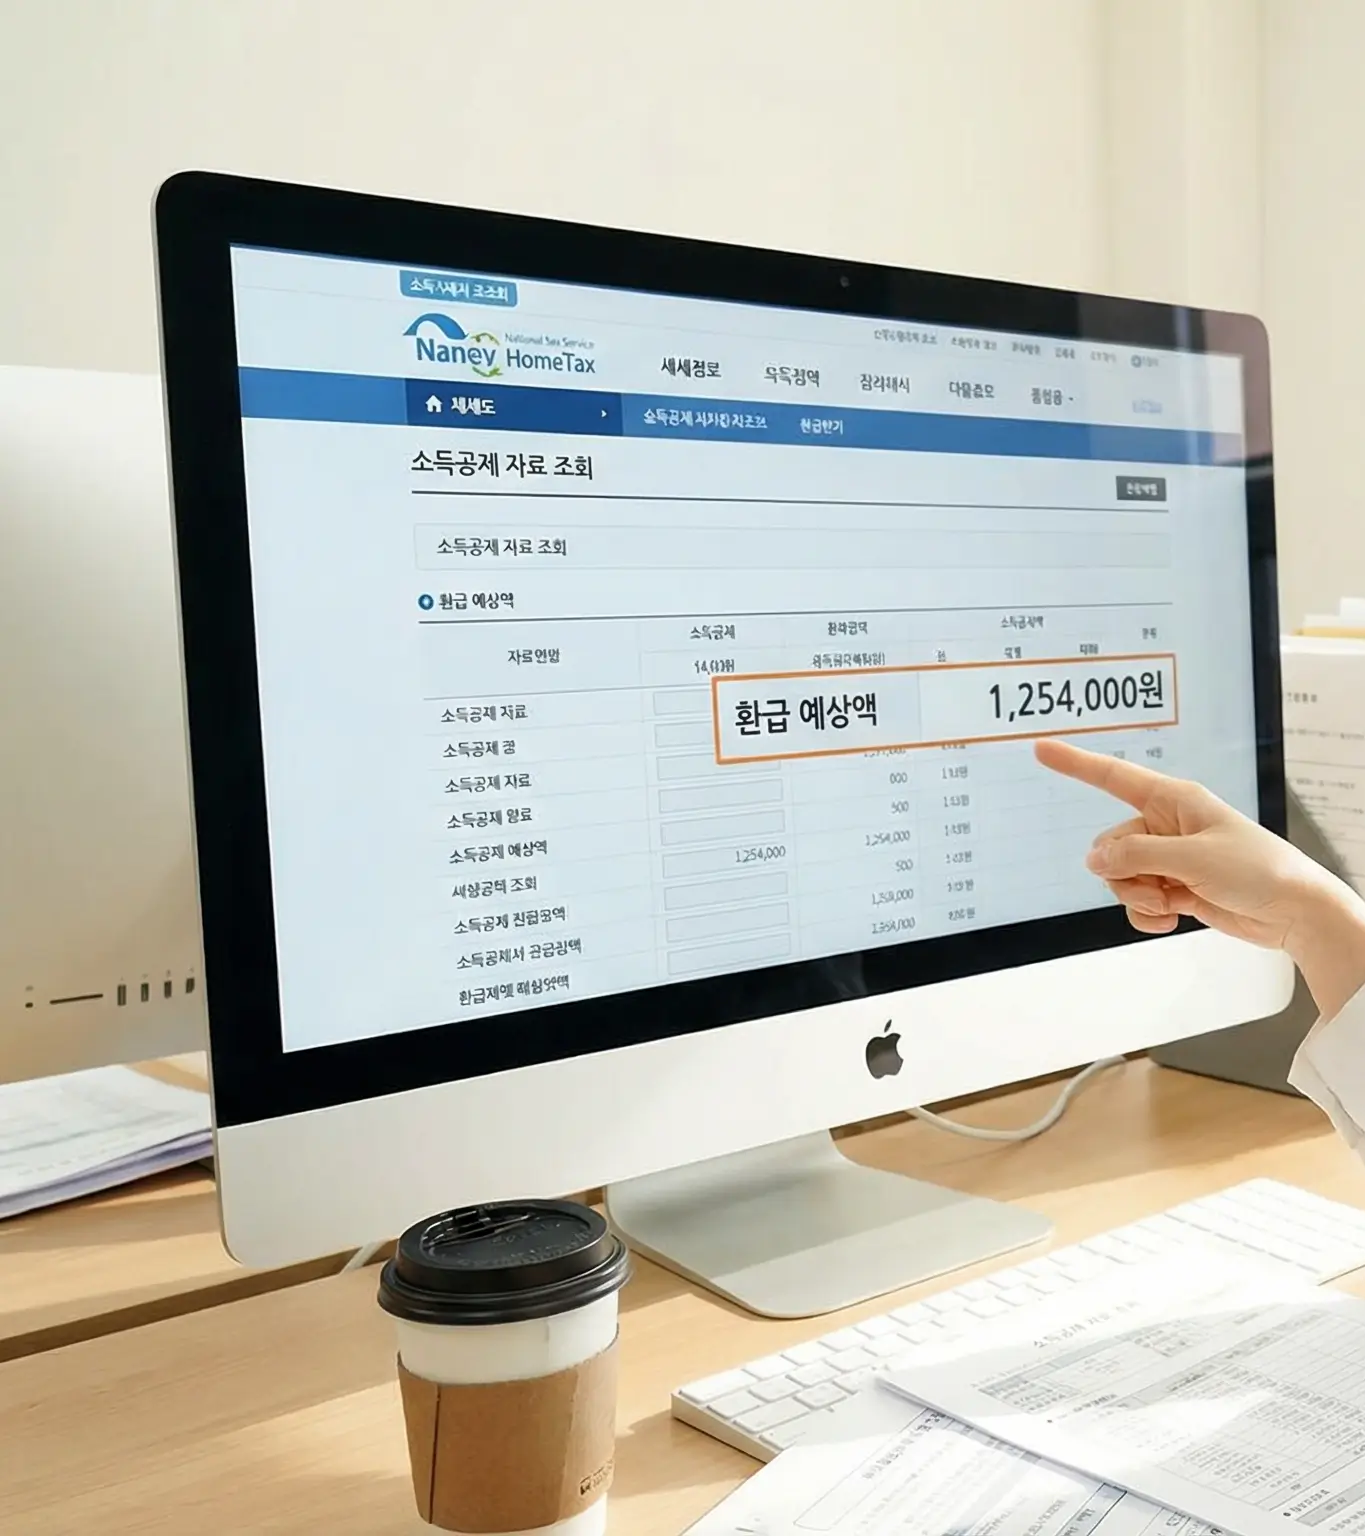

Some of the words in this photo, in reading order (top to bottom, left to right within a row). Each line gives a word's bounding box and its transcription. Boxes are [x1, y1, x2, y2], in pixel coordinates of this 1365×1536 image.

[416, 337, 497, 367] Naney
[506, 347, 596, 374] HomeTax
[411, 450, 500, 478] 소득공제
[506, 453, 548, 478] 자료
[553, 456, 593, 480] 조회
[437, 538, 499, 556] 소득공제
[538, 538, 567, 556] 조회
[734, 699, 791, 737] 환급
[799, 692, 879, 732] 예상액
[988, 670, 1164, 723] 1,254,000원
